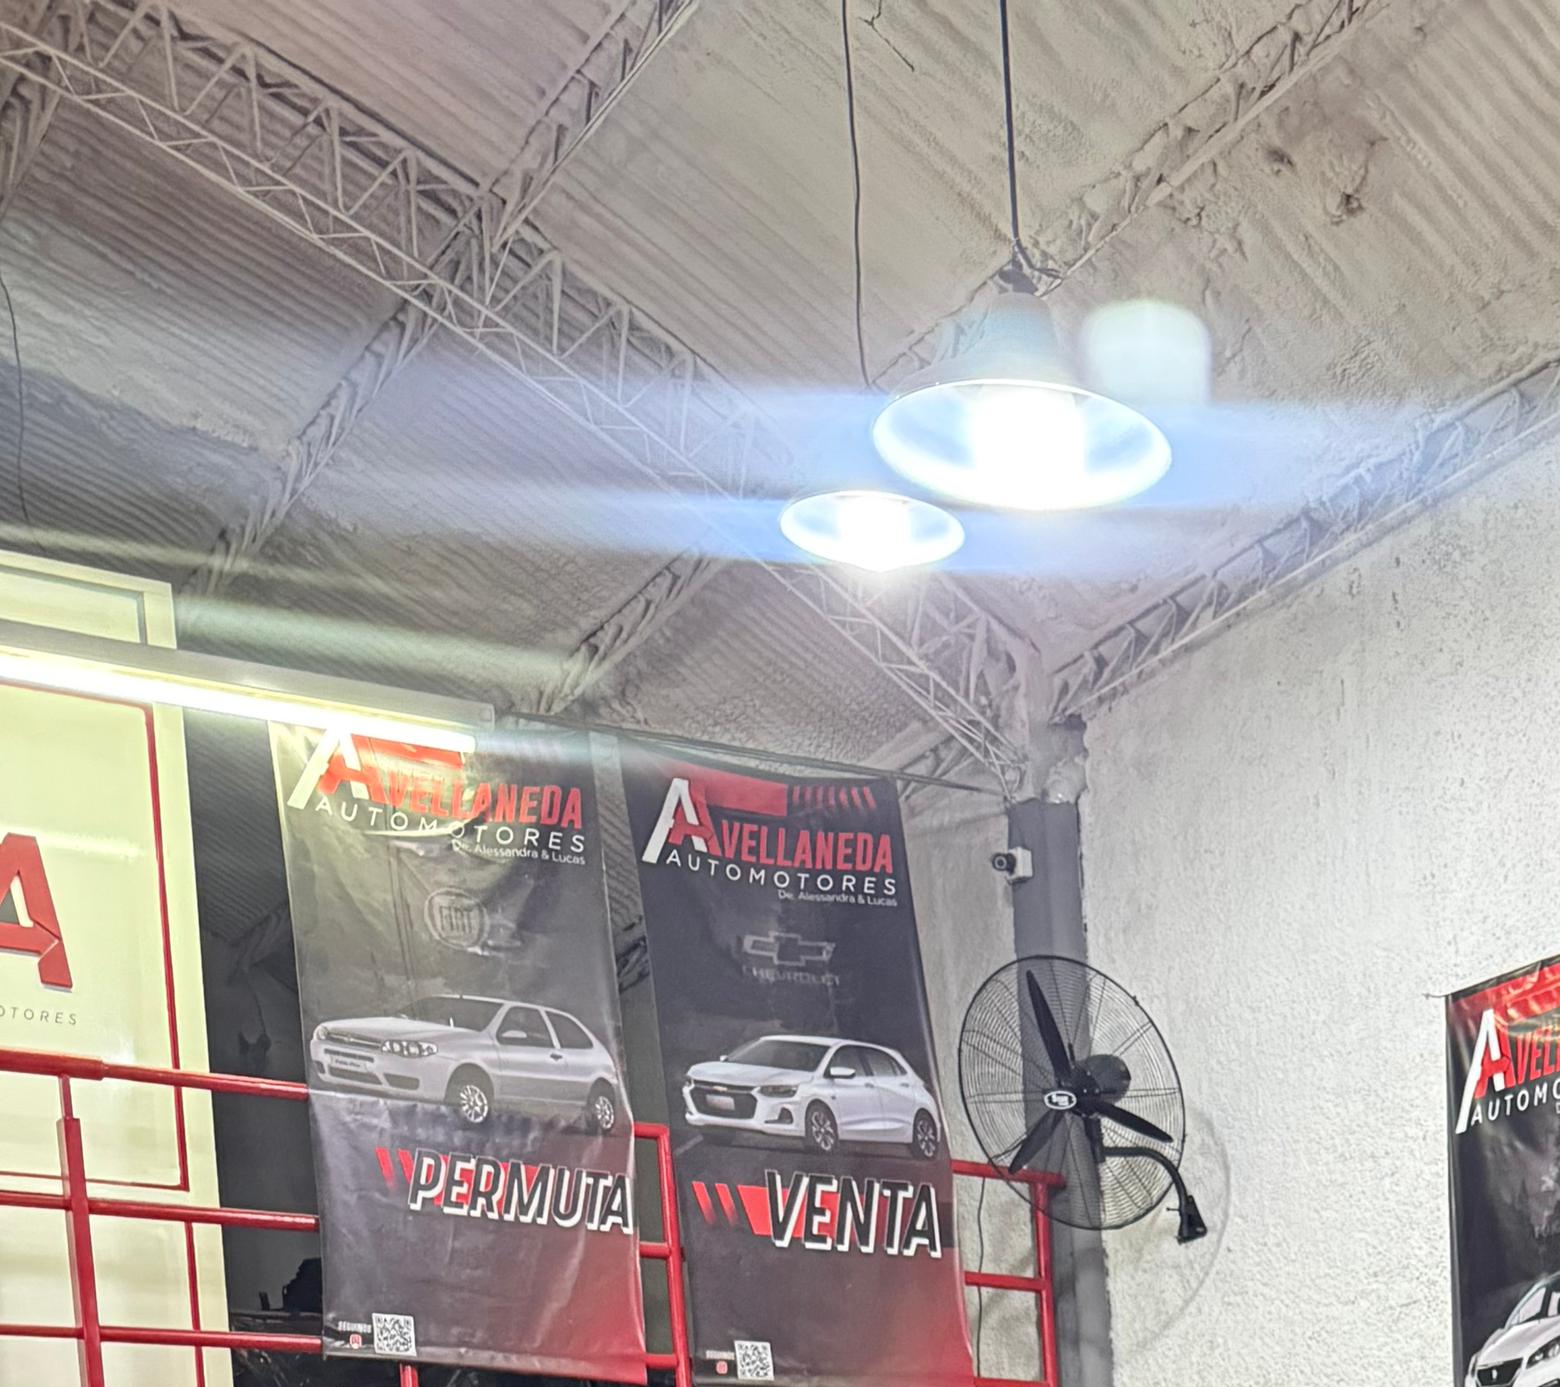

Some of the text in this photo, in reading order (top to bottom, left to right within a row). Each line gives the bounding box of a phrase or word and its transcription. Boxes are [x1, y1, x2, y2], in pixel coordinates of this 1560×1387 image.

[287, 728, 582, 829] AVELLANEDA
[315, 795, 585, 852] AUTOMOTORES
[474, 843, 538, 860] Alessandra
[552, 850, 586, 866] Lucas
[641, 777, 893, 874] AVELLANEDA
[666, 849, 896, 895] AUTOMOTORES
[797, 891, 856, 904] Alessandra
[867, 895, 898, 907] Lucas
[407, 1148, 635, 1235] PERMUTA
[764, 1169, 943, 1258] VENTA
